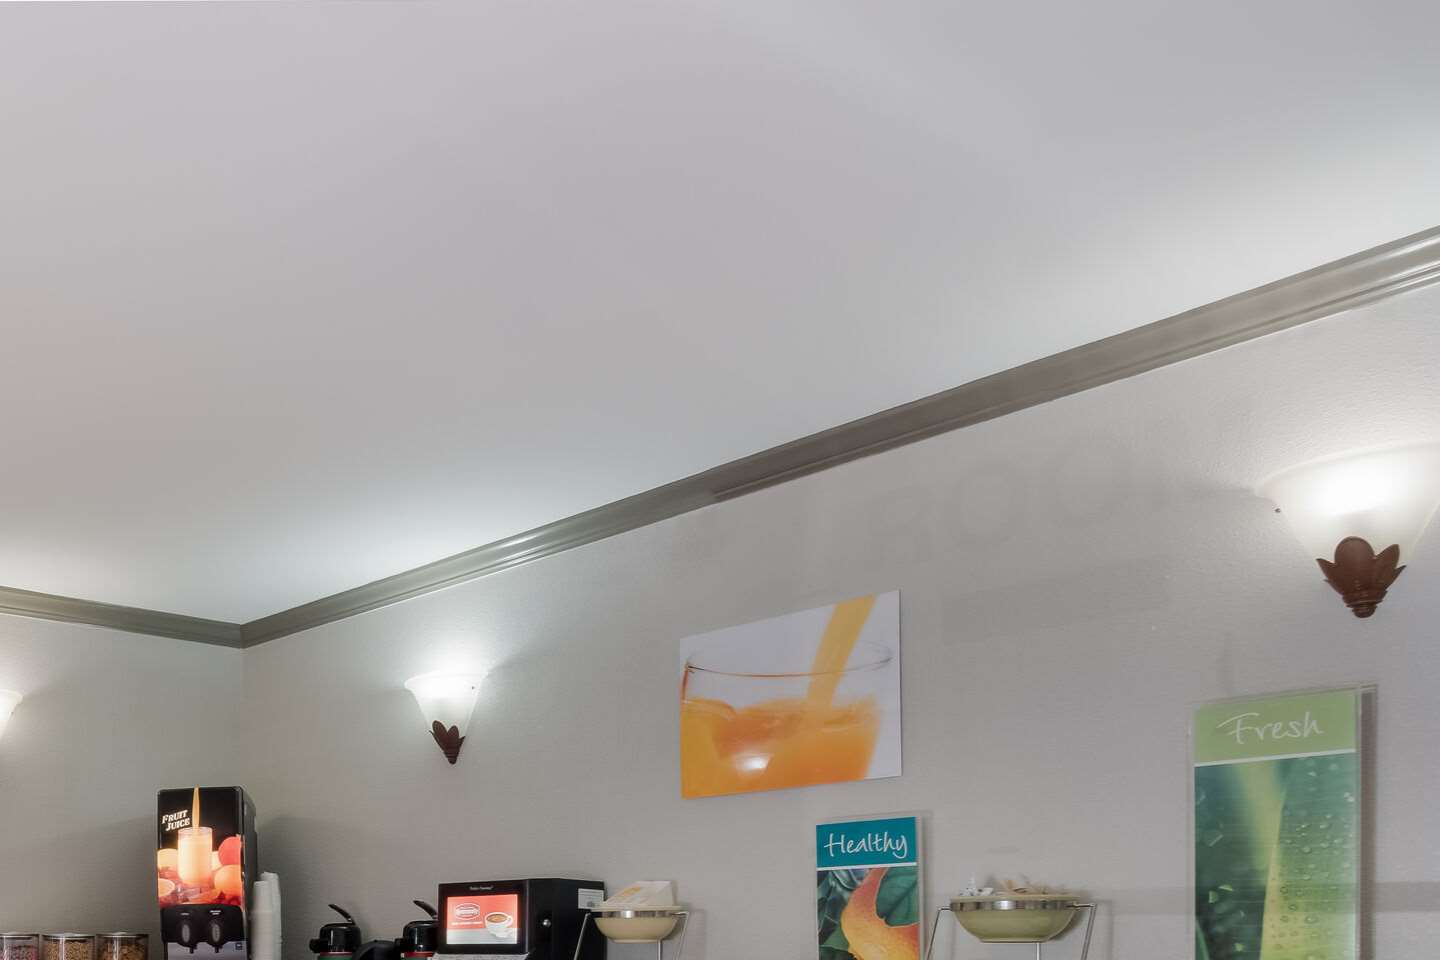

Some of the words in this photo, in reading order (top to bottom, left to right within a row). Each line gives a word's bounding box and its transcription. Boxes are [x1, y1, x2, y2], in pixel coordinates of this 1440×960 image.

[1216, 710, 1324, 745] Fresh
[161, 809, 189, 824] FRUIT
[164, 817, 191, 831] JUICE
[823, 831, 909, 859] Healthy
